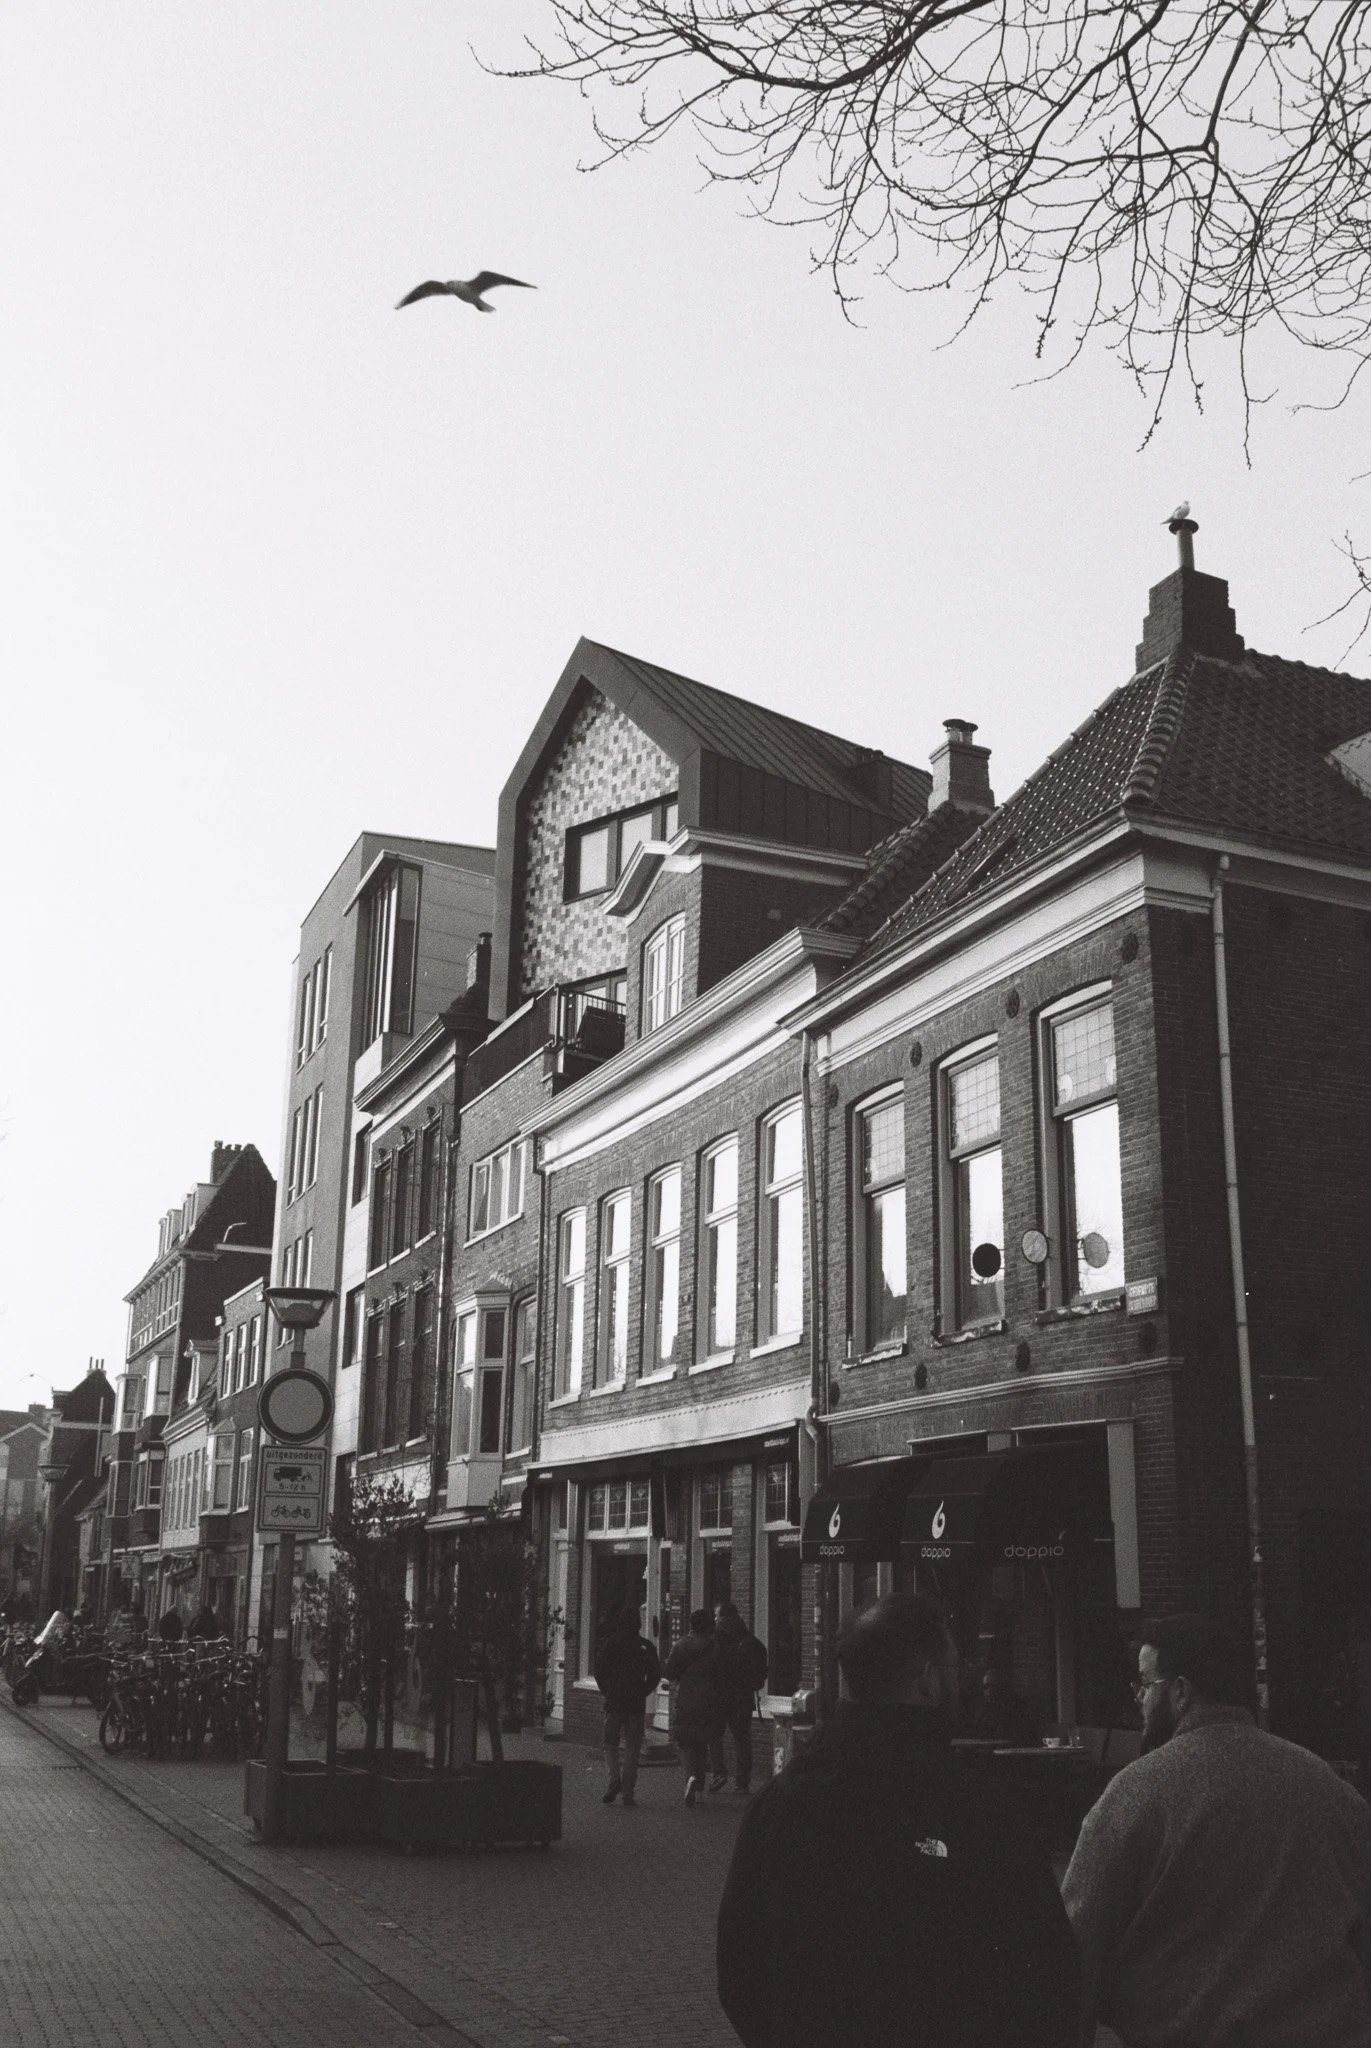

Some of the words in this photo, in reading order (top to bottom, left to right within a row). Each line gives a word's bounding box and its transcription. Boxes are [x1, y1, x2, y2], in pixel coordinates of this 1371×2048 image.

[266, 1451, 323, 1460] uitgezonderd
[819, 1543, 845, 1557] doppio
[921, 1545, 951, 1560] doppio
[1004, 1544, 1064, 1560] doppio
